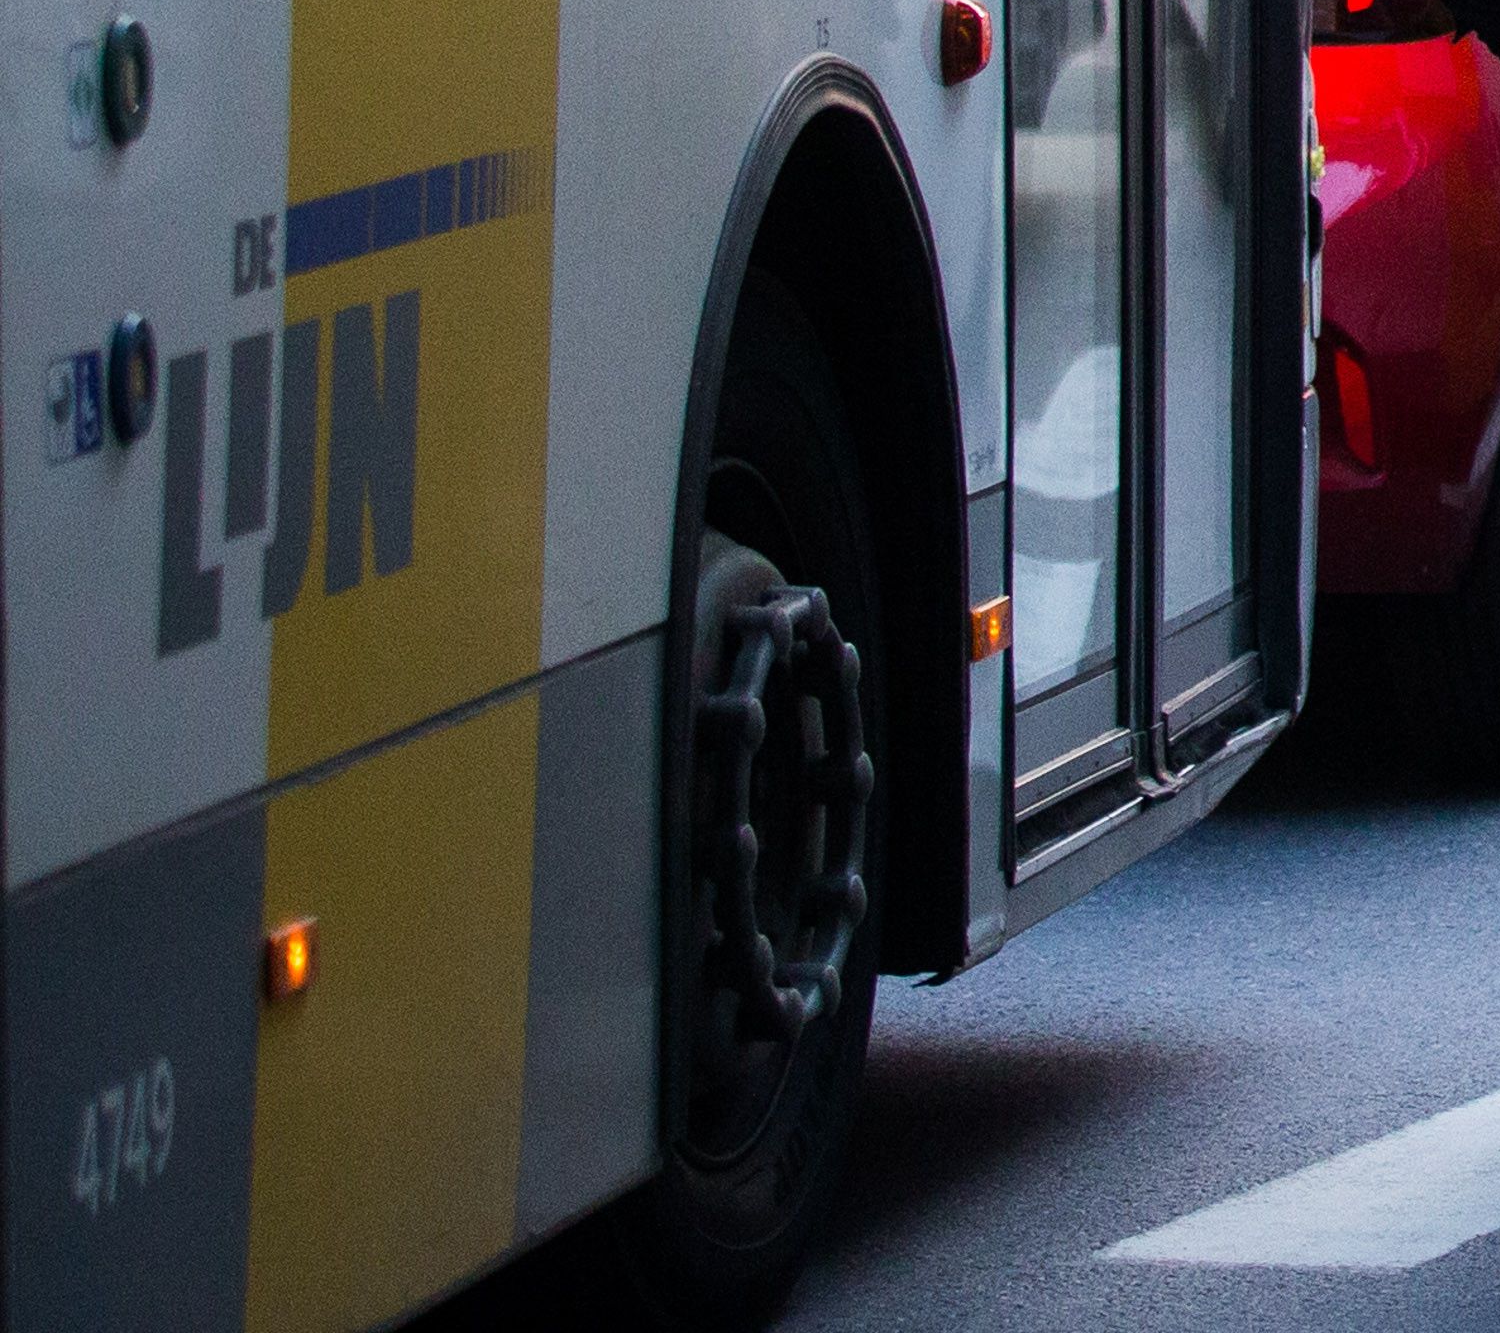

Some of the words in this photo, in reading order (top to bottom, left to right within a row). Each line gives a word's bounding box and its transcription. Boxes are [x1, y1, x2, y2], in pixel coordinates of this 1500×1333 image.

[232, 213, 278, 298] DE
[155, 288, 421, 659] LIJN
[72, 1055, 176, 1217] 4749
